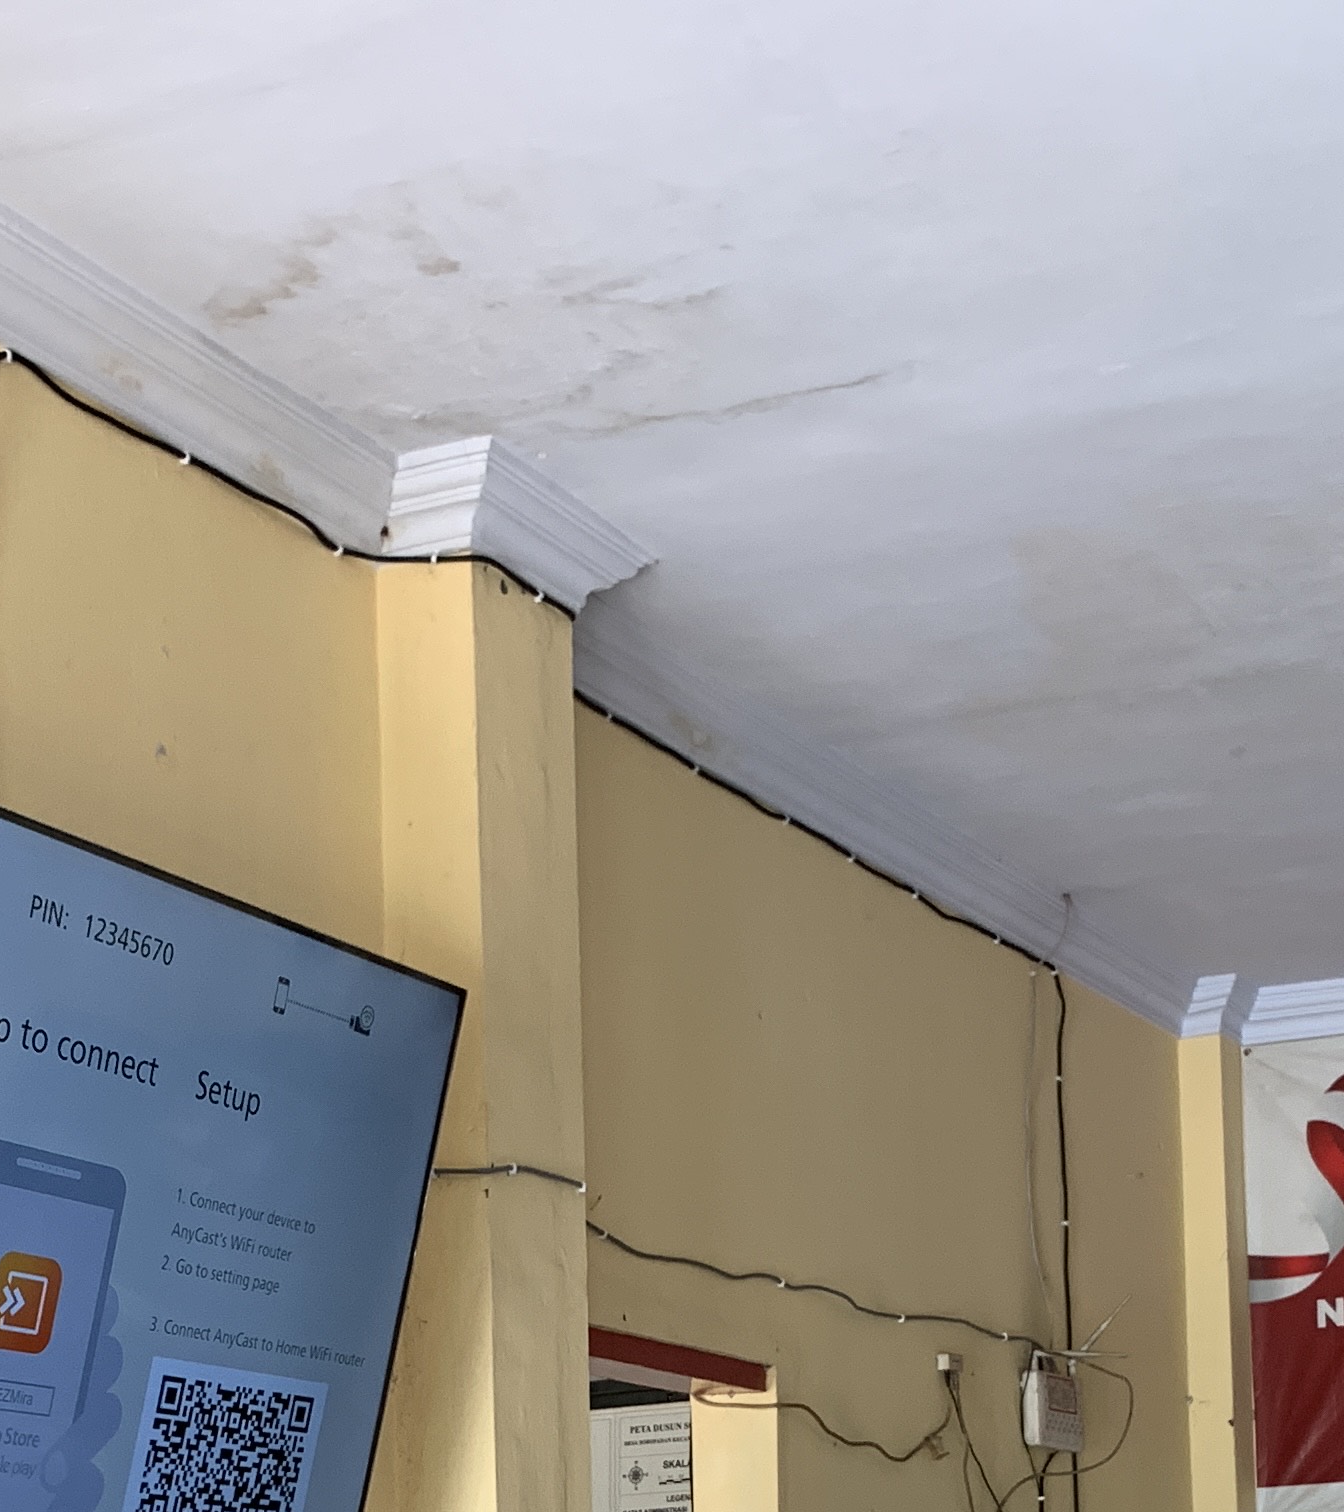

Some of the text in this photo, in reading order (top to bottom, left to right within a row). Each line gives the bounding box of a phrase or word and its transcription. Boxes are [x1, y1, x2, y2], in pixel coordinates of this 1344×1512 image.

[29, 894, 175, 966] PIN: 12345670
[20, 1018, 49, 1055] to
[56, 1034, 160, 1088] connect
[194, 1071, 262, 1123] Setup
[177, 1188, 316, 1235] 1. Connect your device to
[171, 1222, 293, 1262] AnyCast's WiFi router
[161, 1255, 281, 1296] 2. Go to setting page
[149, 1316, 366, 1368] 3. Connect AnyCast to Home WiFi router
[3, 1427, 41, 1448] Store
